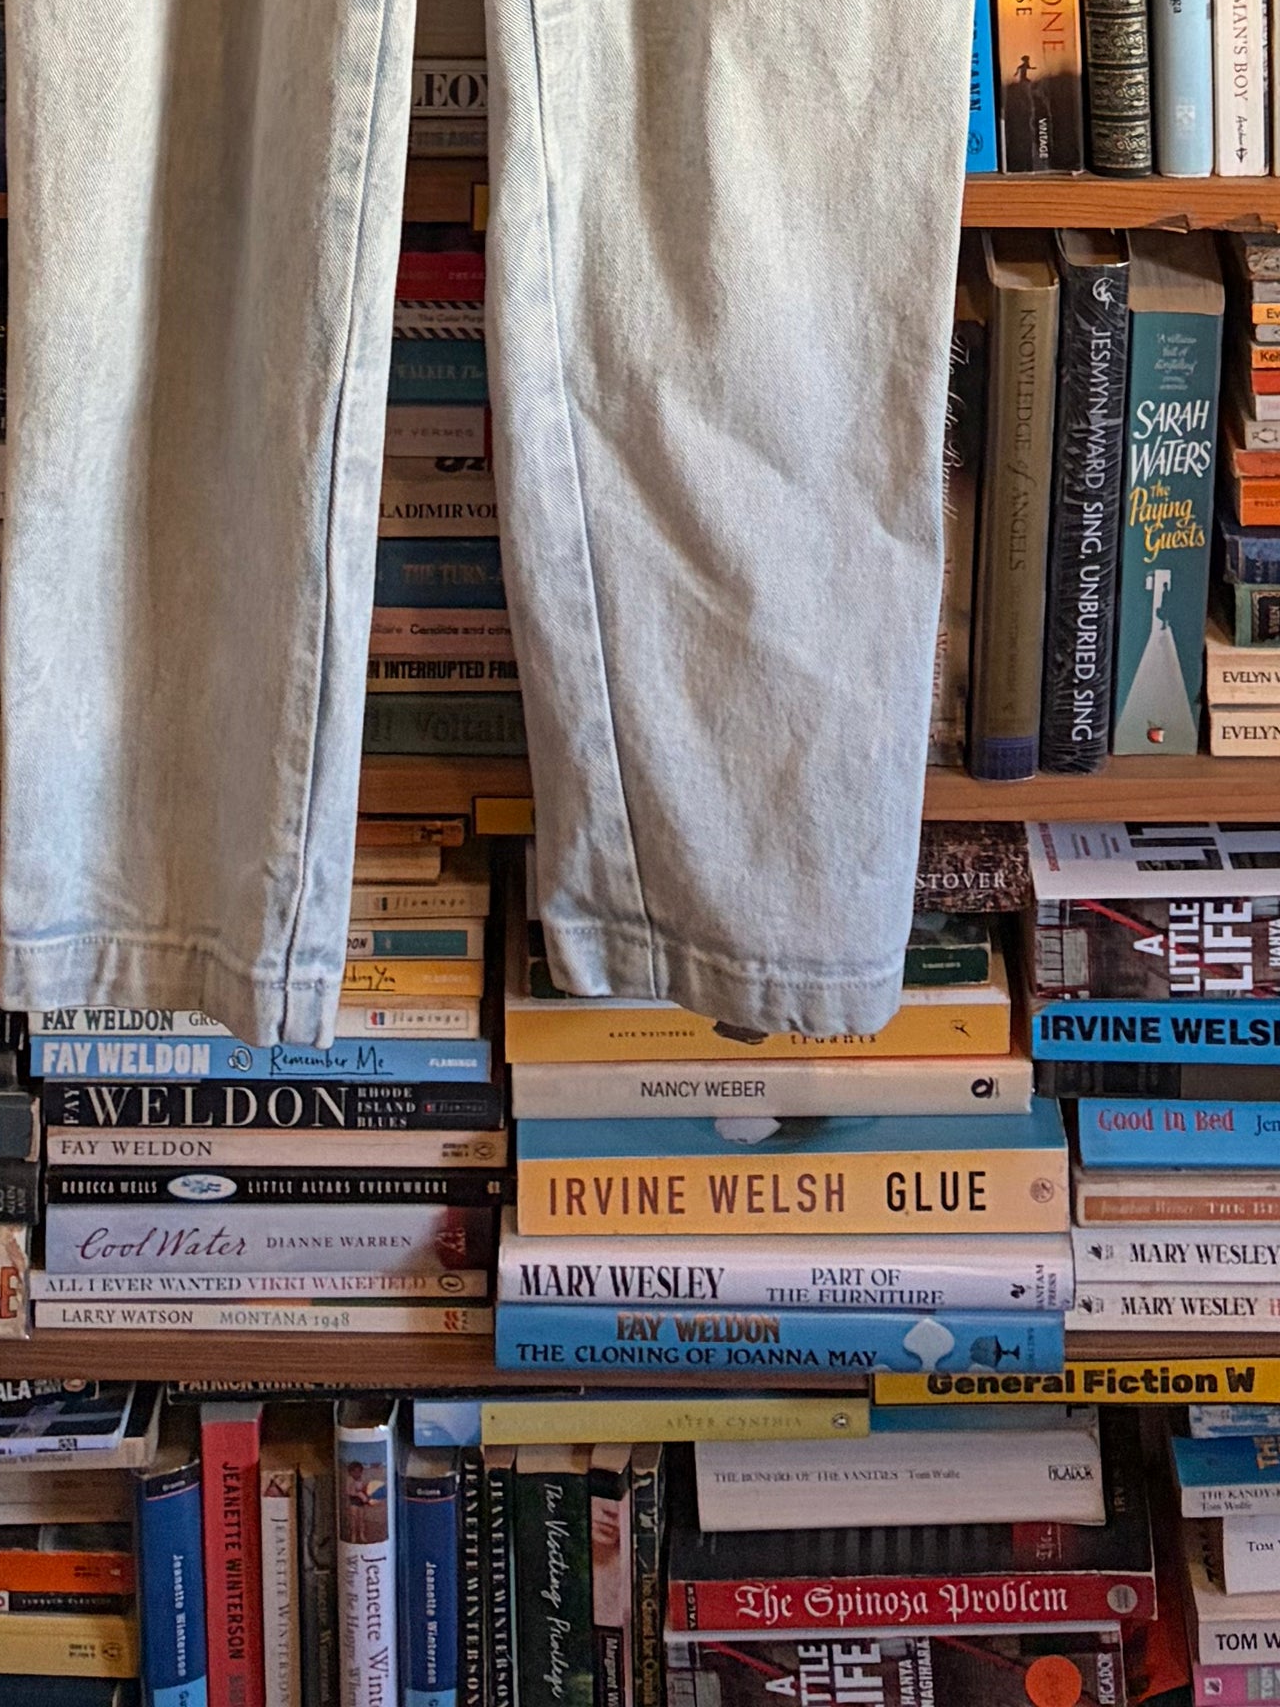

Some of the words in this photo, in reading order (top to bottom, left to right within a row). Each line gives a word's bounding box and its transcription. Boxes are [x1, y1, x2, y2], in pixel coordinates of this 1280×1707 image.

[1133, 400, 1210, 438] SARAH
[1130, 440, 1211, 478] WATERS
[91, 1085, 350, 1128] WELDON
[548, 1176, 686, 1215] IRVINE
[708, 1174, 846, 1214] WELSH
[886, 1171, 986, 1212] GLUE
[520, 1263, 612, 1299] MARY
[620, 1265, 725, 1301] WESLEY
[928, 1371, 1074, 1395] General
[1084, 1370, 1219, 1395] Fiction
[1227, 1368, 1255, 1394] W
[1215, 1631, 1259, 1650] TOM
